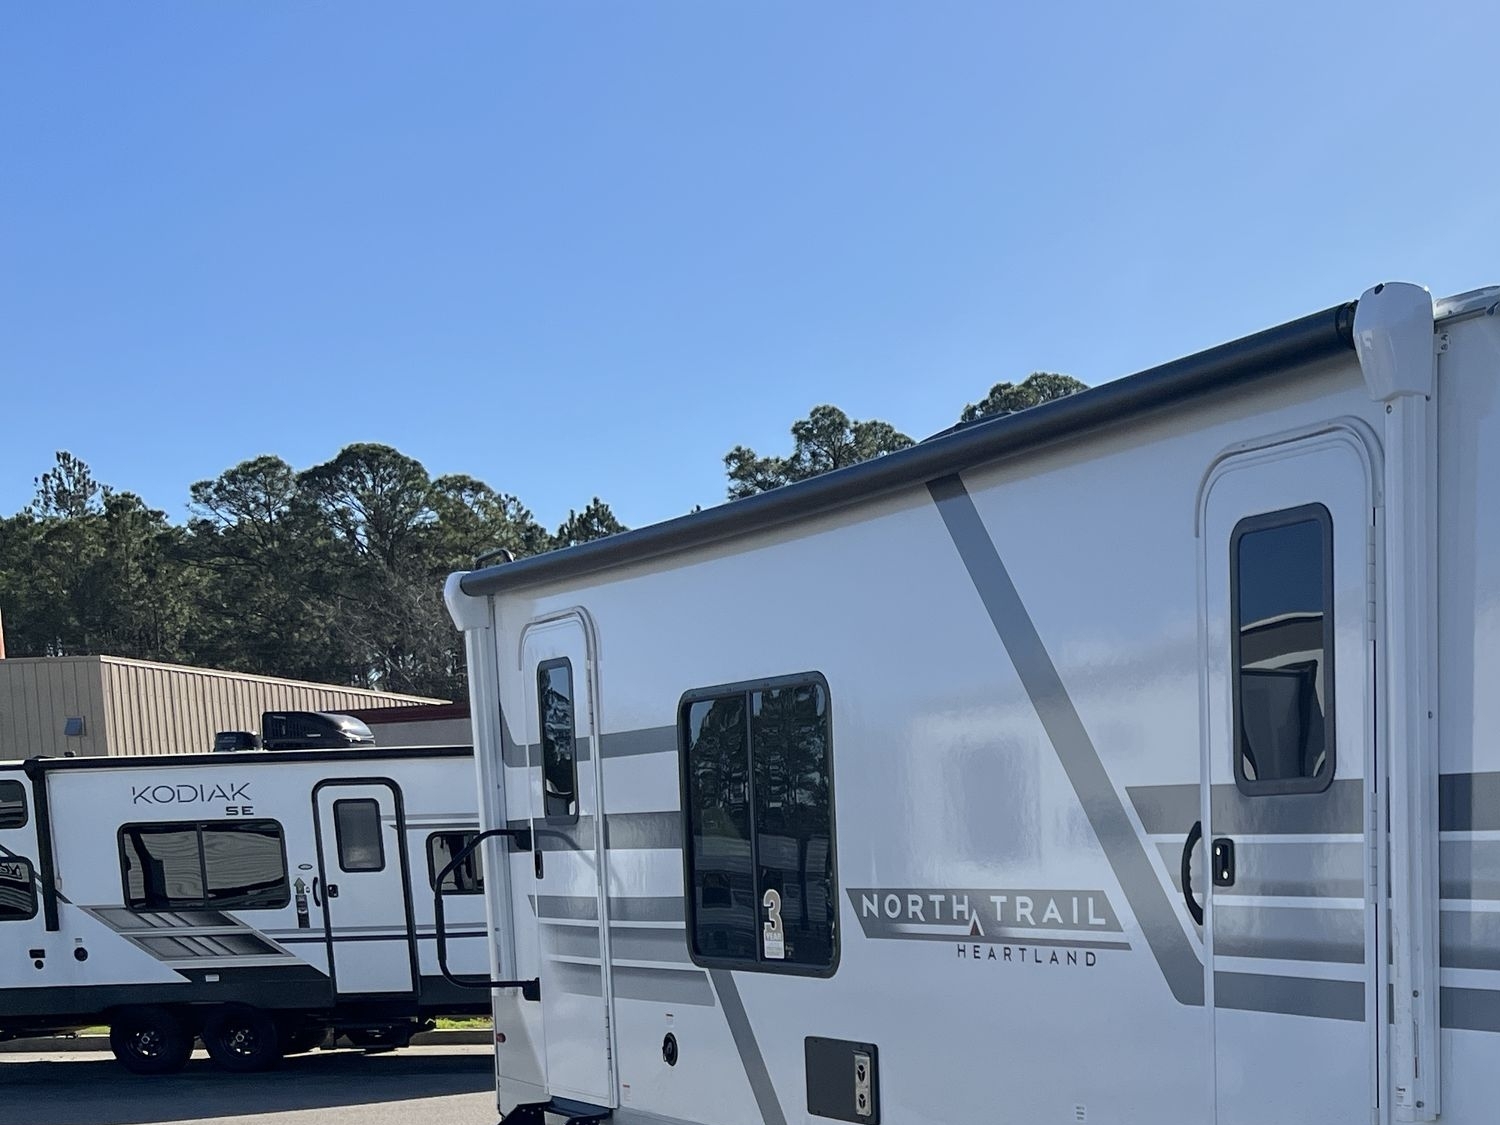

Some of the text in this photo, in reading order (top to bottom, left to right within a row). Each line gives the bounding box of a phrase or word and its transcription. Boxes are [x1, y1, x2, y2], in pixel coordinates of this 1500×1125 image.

[132, 782, 252, 804] KODIAK
[225, 806, 254, 816] SE
[763, 888, 783, 931] 3
[861, 893, 1107, 925] NORTH TRAIL
[956, 943, 1097, 967] HEARTLAND
